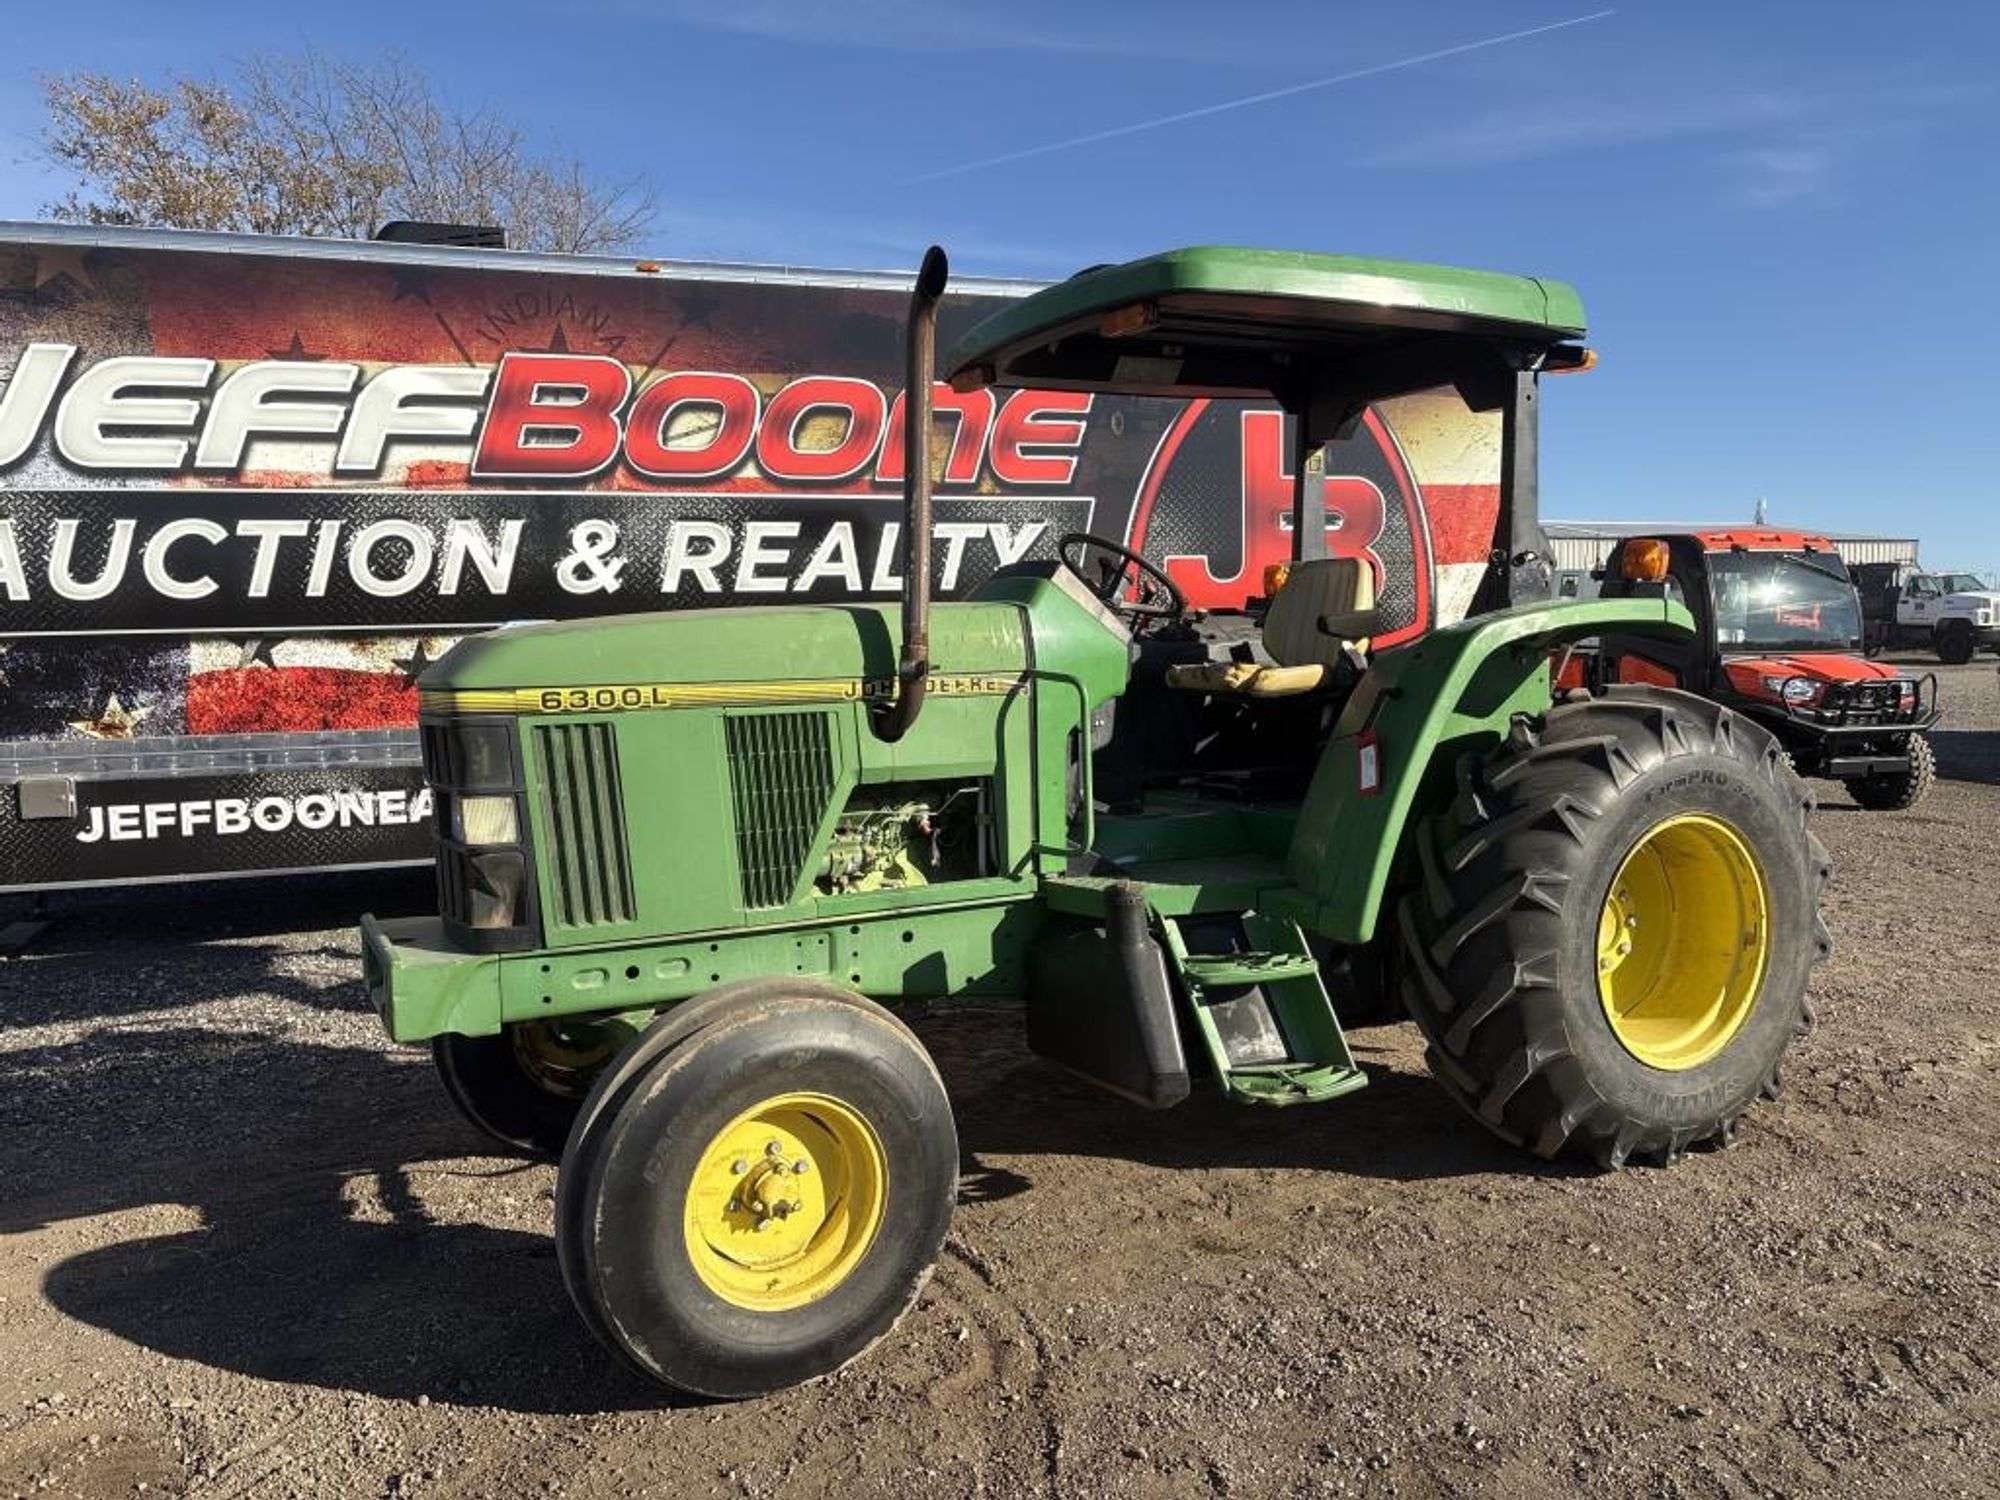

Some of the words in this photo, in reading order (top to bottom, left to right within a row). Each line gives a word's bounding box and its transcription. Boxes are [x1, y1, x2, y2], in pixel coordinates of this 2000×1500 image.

[476, 291, 626, 355] INDIANA
[0, 518, 525, 600] AUCTION
[556, 518, 624, 594] &
[660, 520, 1048, 594] REALTY
[540, 687, 668, 711] 6300L
